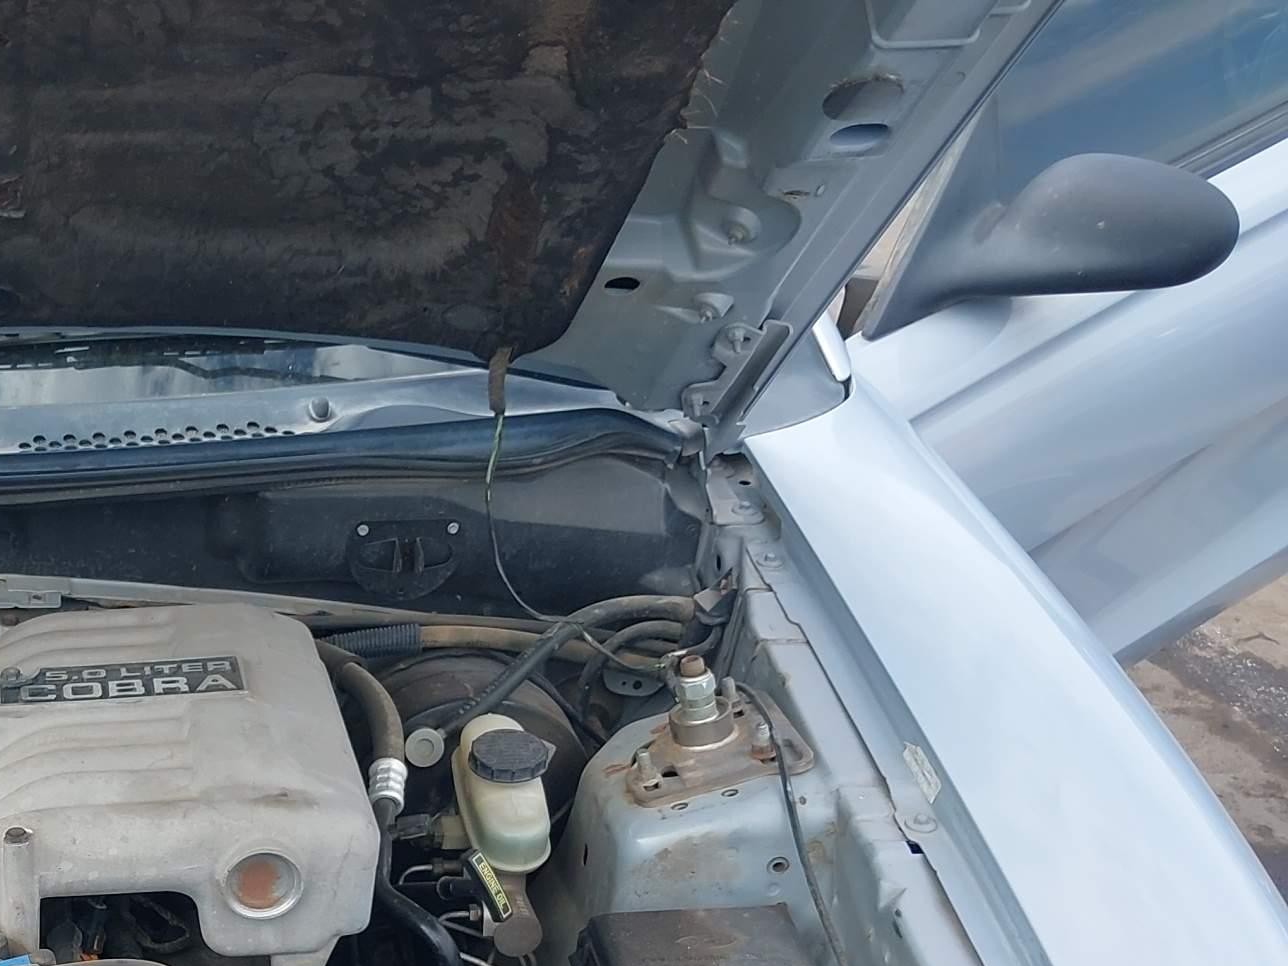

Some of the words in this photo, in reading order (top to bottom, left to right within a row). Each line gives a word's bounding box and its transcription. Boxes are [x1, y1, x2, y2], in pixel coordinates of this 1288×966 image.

[45, 668, 106, 681] 5.0
[120, 660, 232, 677] LITER
[20, 674, 238, 701] COBRA
[479, 862, 500, 893] ENGINE
[496, 893, 507, 909] OIL
